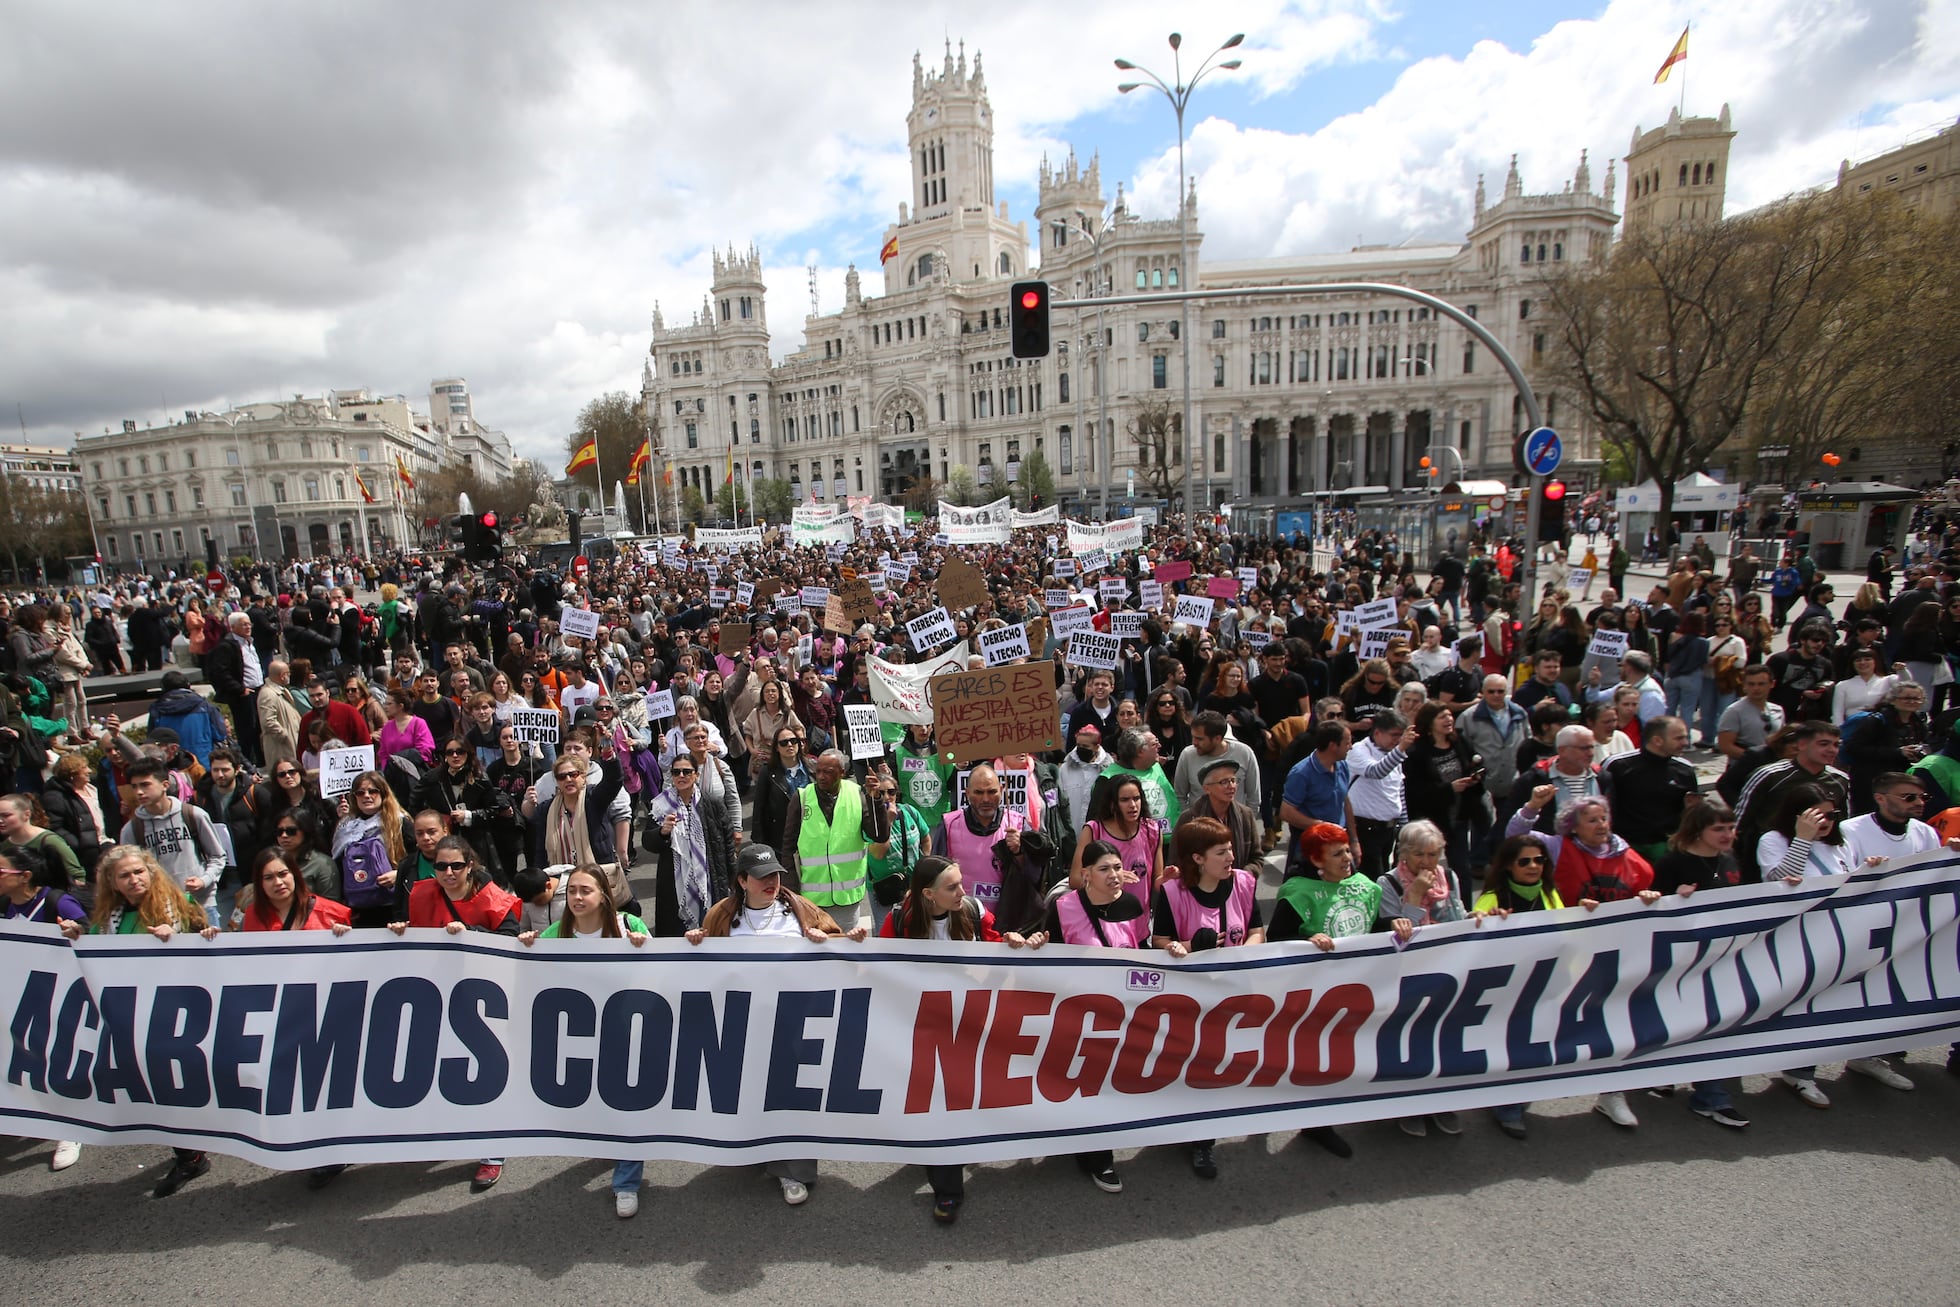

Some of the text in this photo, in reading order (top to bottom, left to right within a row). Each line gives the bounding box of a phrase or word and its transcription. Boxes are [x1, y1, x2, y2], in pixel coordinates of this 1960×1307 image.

[910, 611, 945, 634] DERECHO
[1112, 615, 1147, 623] DERECHO
[1112, 624, 1142, 632] A TECH
[919, 627, 953, 649] A TECHO.
[982, 627, 1021, 647] DERECHO
[1059, 625, 1068, 634] SIN
[1072, 632, 1119, 650] DERECHO
[989, 644, 1026, 663] A TECHO.
[1069, 643, 1117, 661] A TECHO
[1073, 655, 1091, 663] JUSTO
[1092, 658, 1115, 667] PRECIO!
[1364, 647, 1371, 657] A
[1011, 669, 1044, 693] ES
[881, 701, 892, 710] LA
[892, 699, 922, 713] CALLE
[939, 691, 1055, 727] NUESTRA, SUS
[513, 712, 557, 728] DERECHO
[848, 709, 878, 726] DERECHO
[513, 728, 519, 741] A
[851, 727, 881, 745] A TECHO
[938, 723, 989, 747] CASAS
[344, 754, 366, 770] S.O.S.
[913, 780, 939, 792] STOP
[960, 774, 1027, 790] DCHO
[1336, 881, 1370, 899] CASA
[1337, 914, 1361, 933] STOP
[1655, 893, 1960, 1048] VIVIEN
[8, 949, 1620, 1116] ACABEMOS CON EL NEGOCIO DE LA
